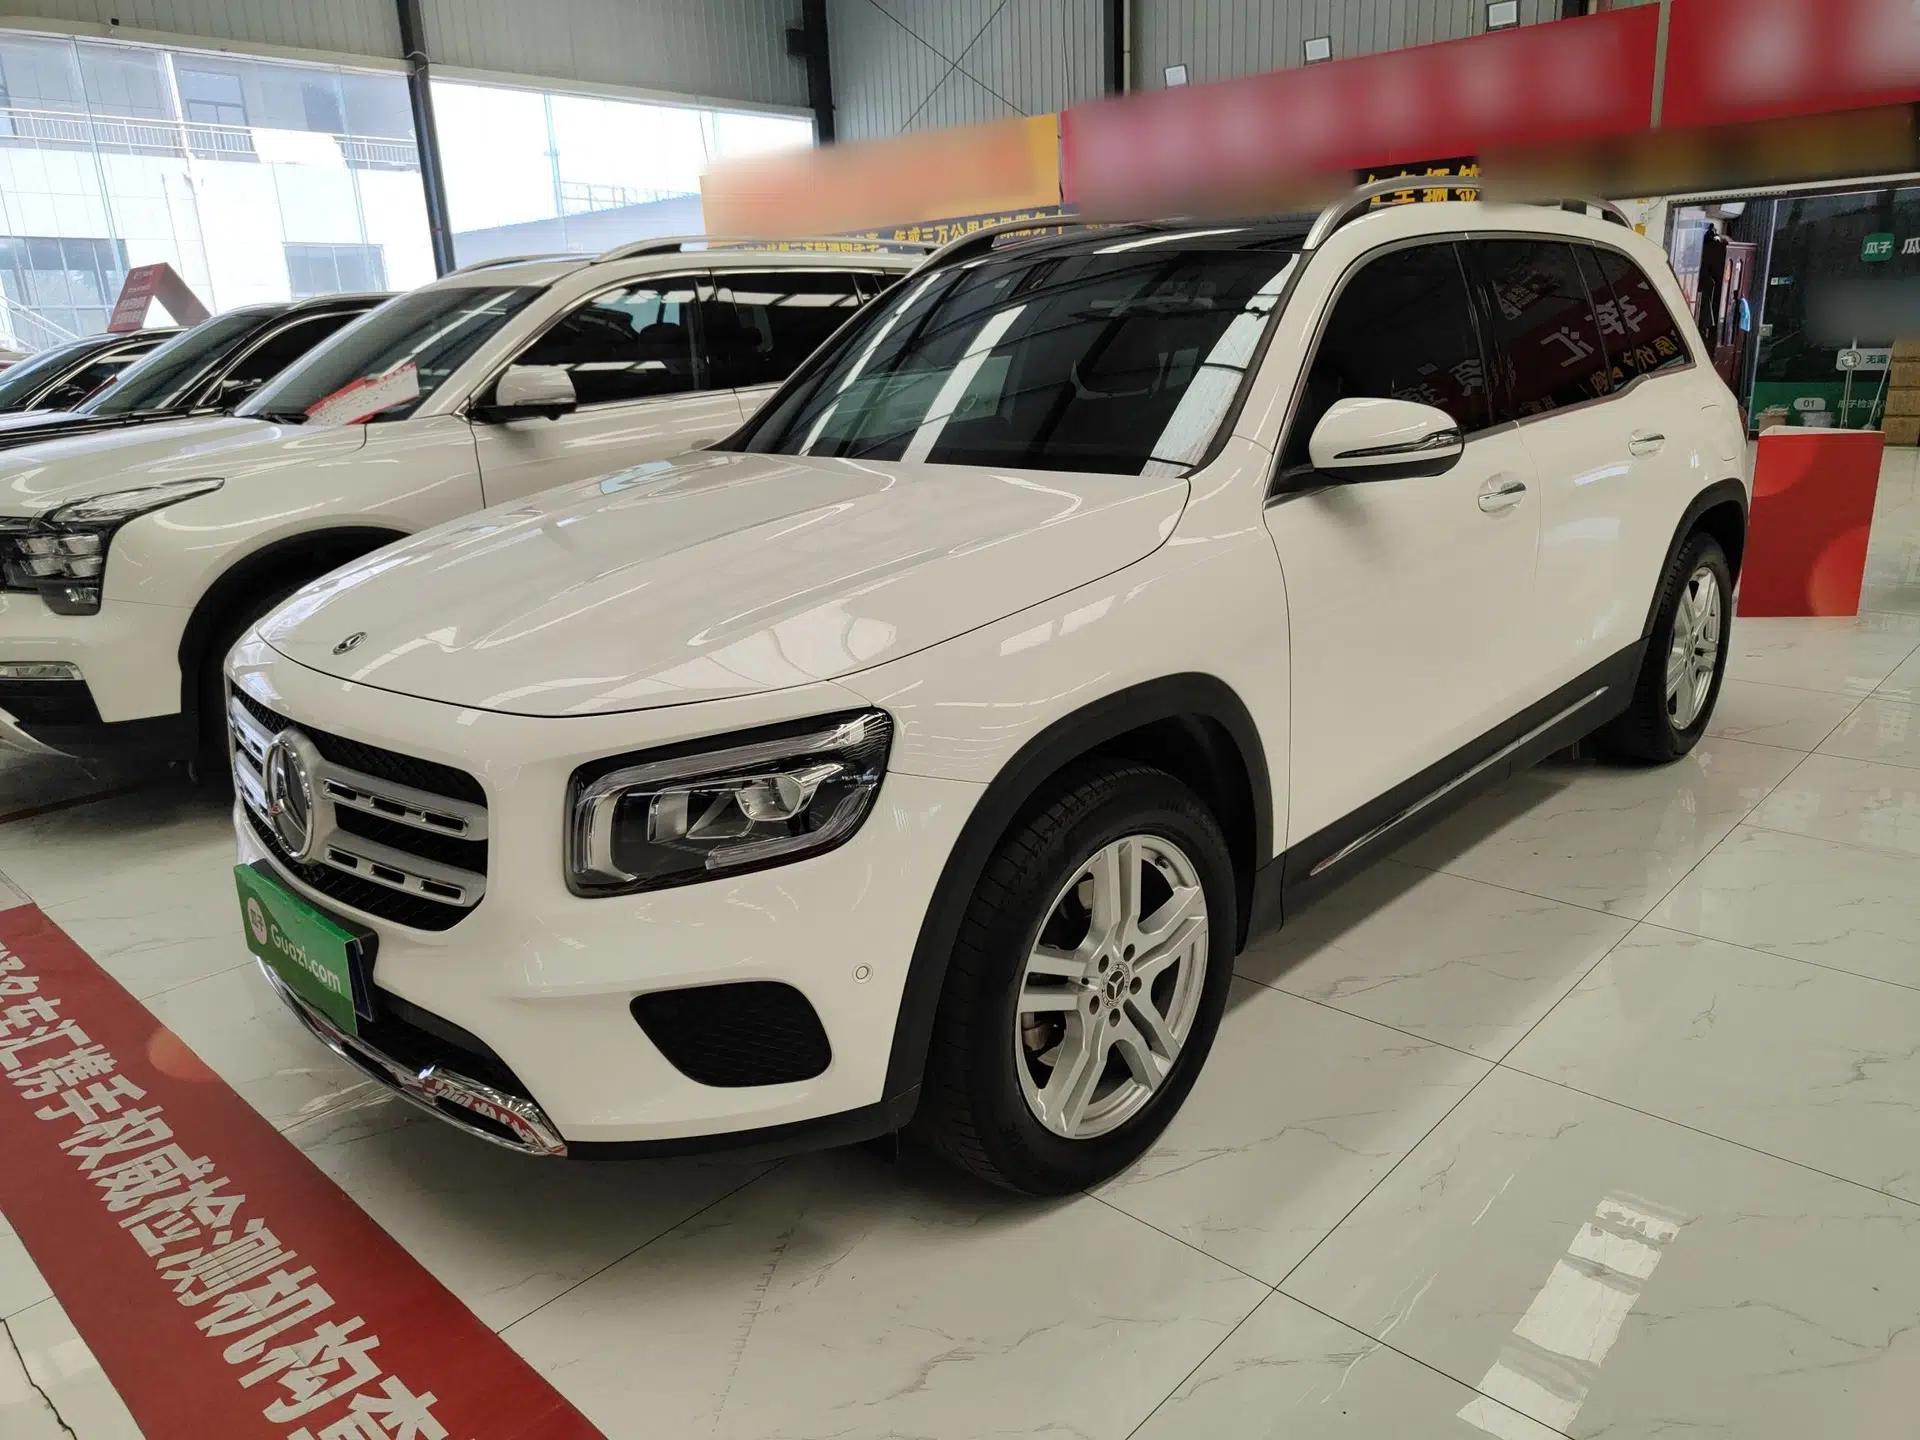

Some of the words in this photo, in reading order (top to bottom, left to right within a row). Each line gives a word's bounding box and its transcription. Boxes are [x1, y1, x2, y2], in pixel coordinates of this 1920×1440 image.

[1864, 241, 1892, 255] 瓜子
[1803, 400, 1815, 408] 01
[270, 924, 341, 993] Guazi.com
